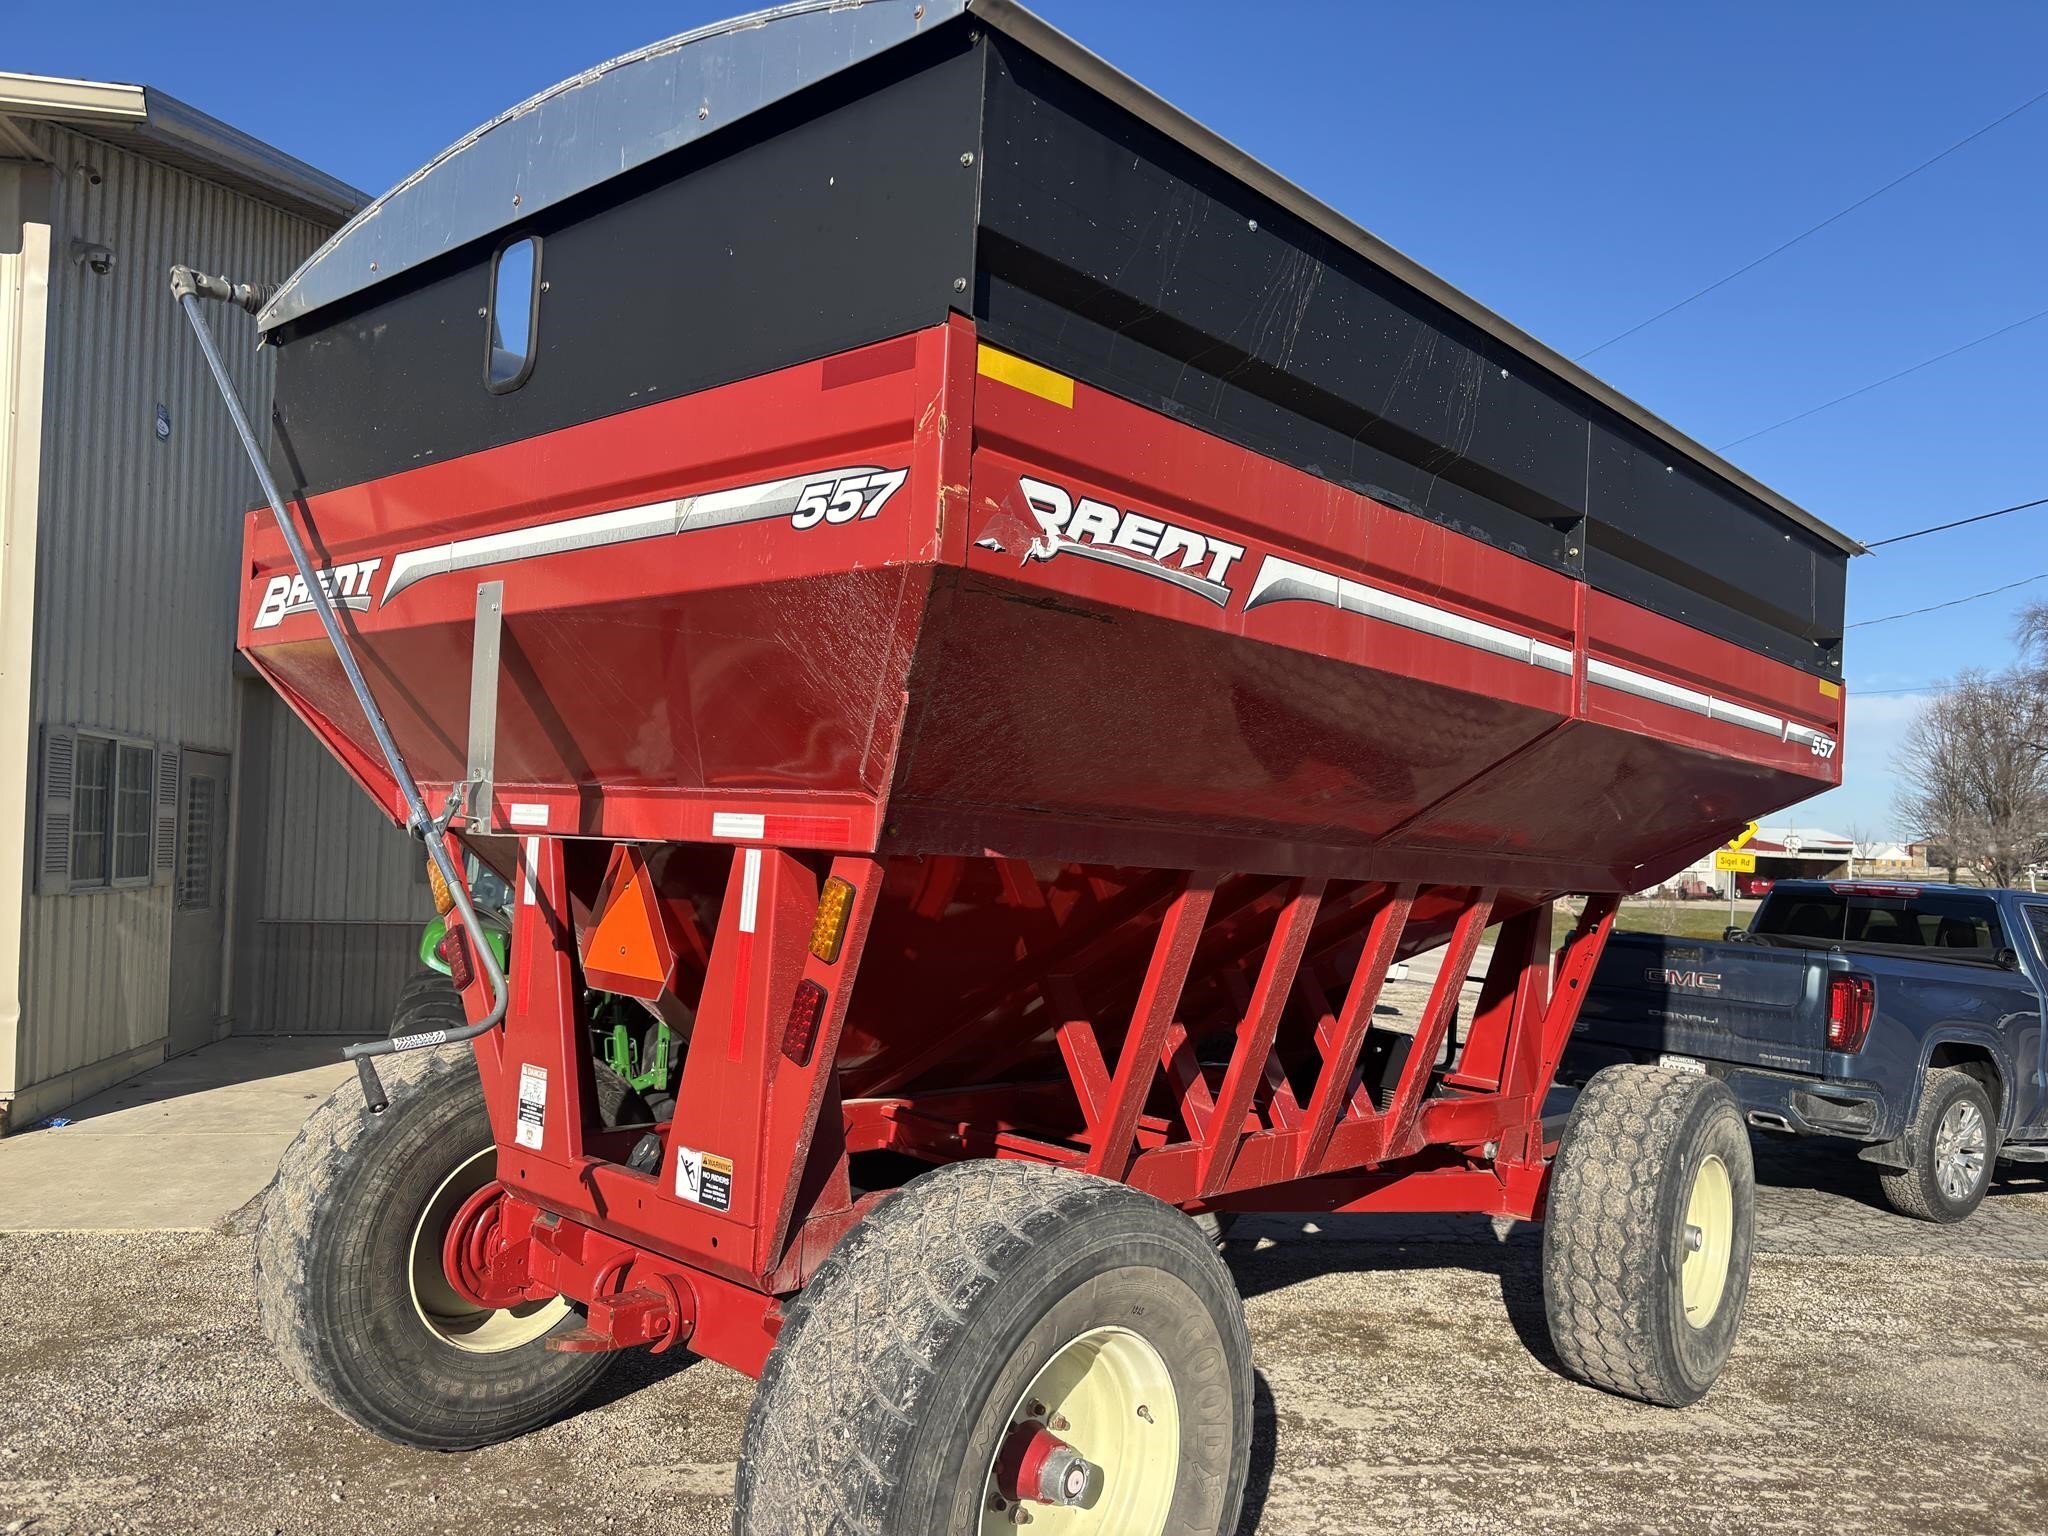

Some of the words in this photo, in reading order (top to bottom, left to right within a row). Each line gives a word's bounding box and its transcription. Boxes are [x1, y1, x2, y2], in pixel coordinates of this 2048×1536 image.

[791, 466, 910, 530] 557
[1811, 734, 1837, 758] 557
[1720, 856, 1738, 867] Sigel
[1740, 859, 1750, 867] Rd
[1645, 968, 1721, 990] GMC
[707, 1158, 732, 1172] WARNING
[702, 1170, 711, 1180] NO
